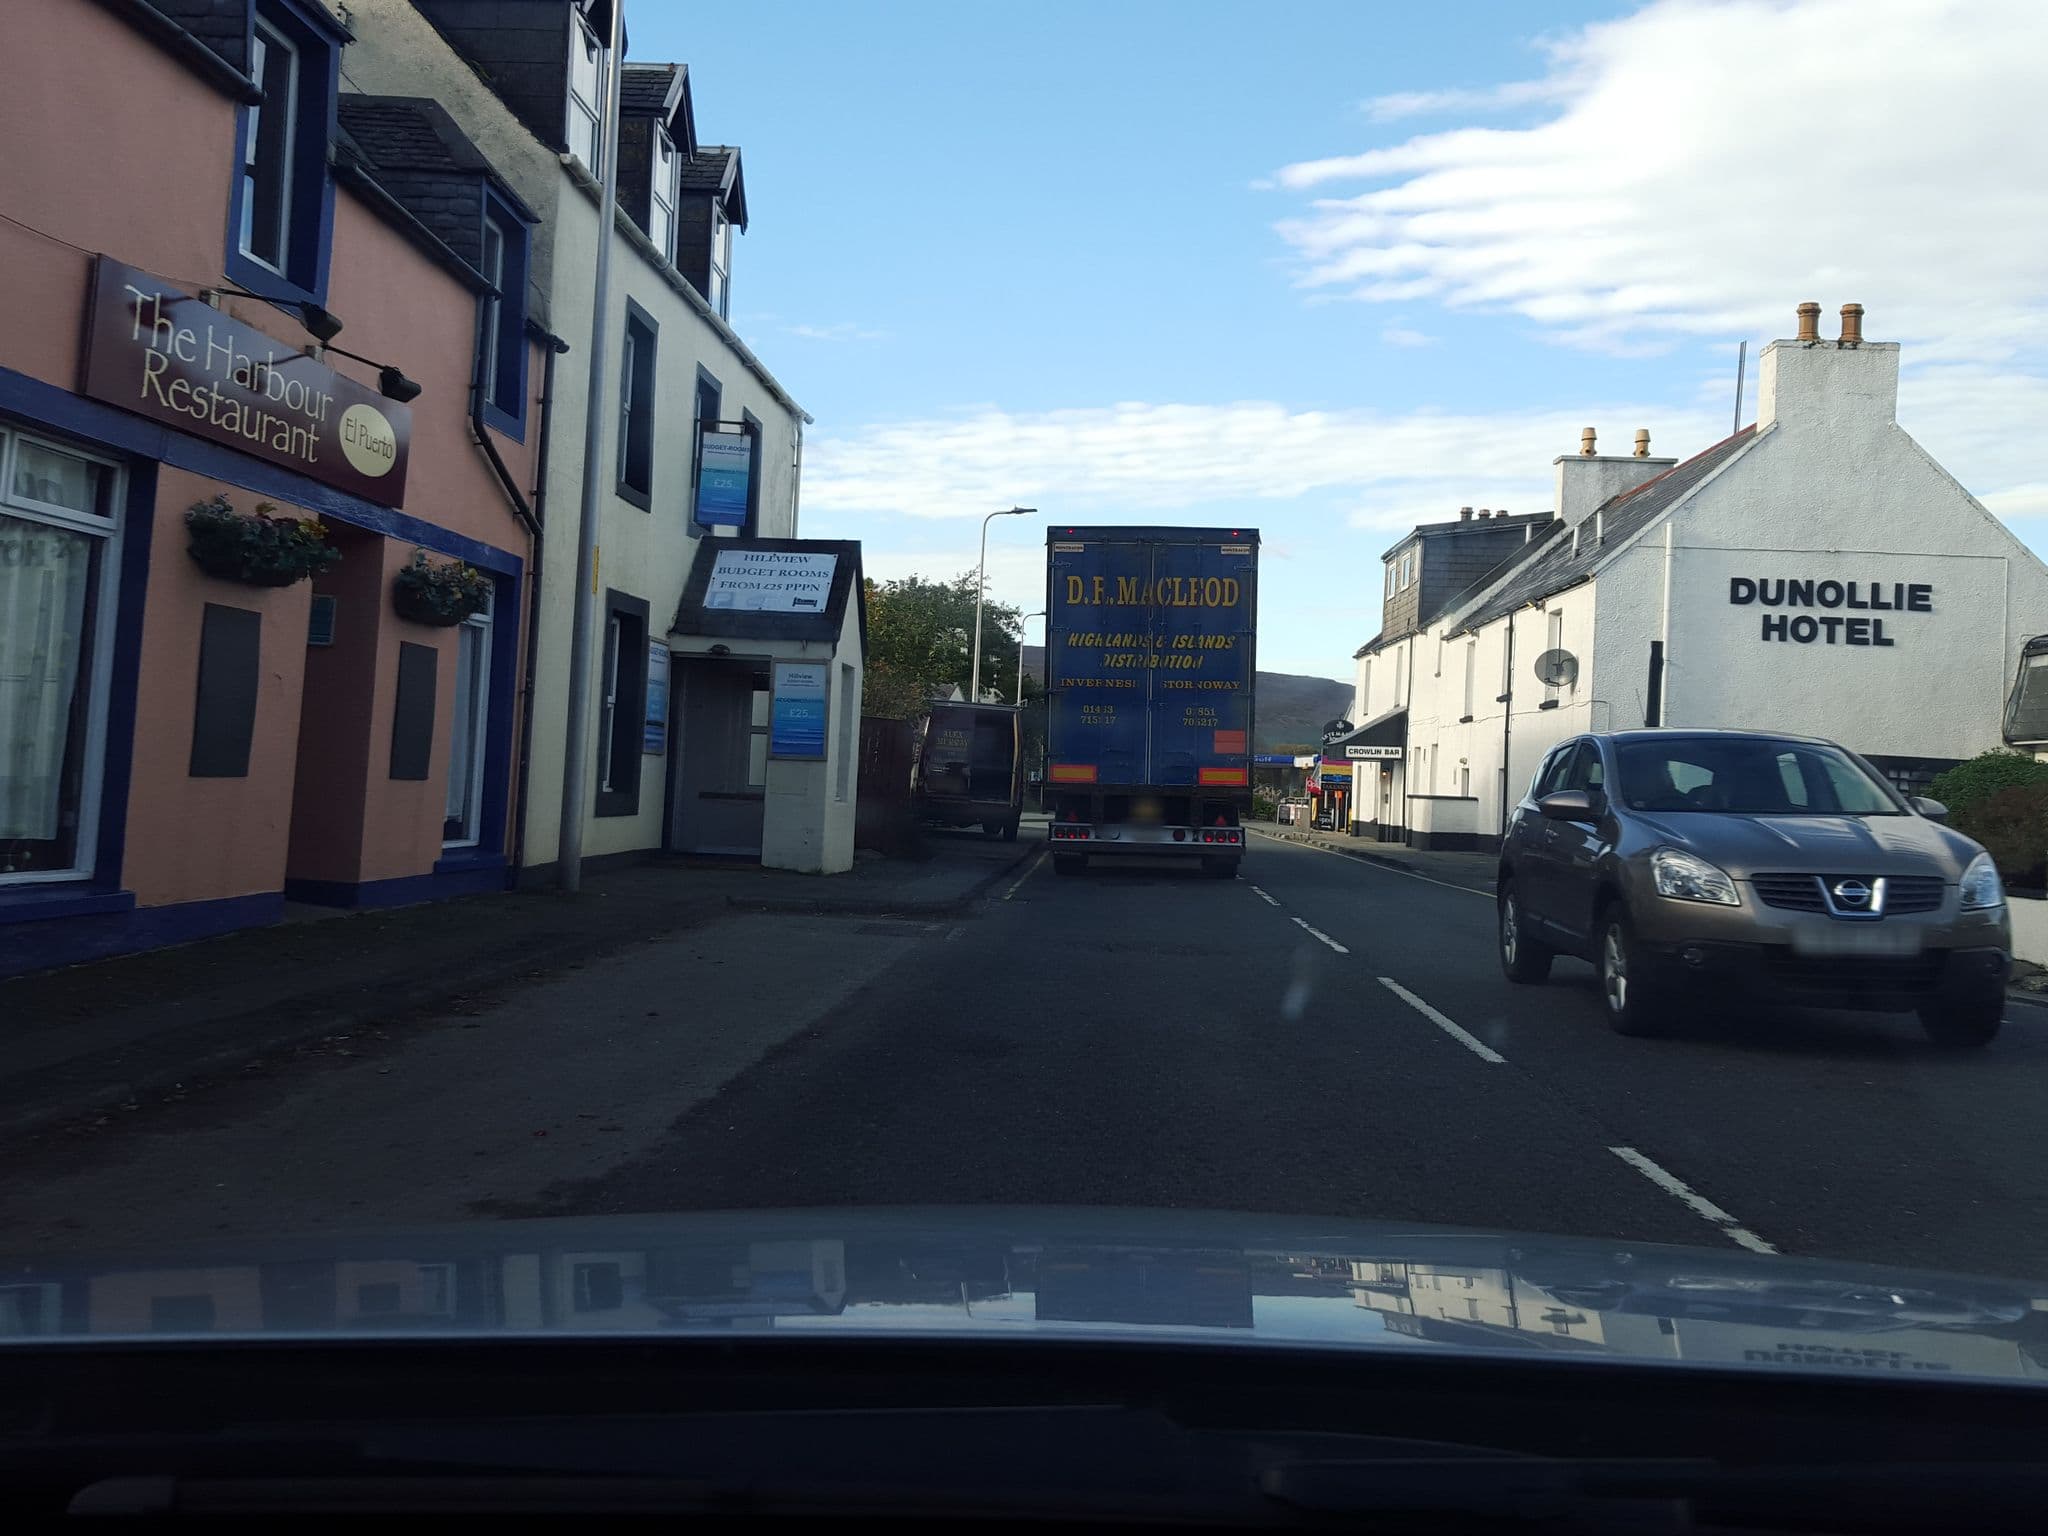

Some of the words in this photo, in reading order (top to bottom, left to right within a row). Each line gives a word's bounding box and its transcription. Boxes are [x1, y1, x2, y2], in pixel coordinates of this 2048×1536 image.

[124, 284, 196, 362] The
[205, 325, 334, 422] Harbour
[141, 347, 320, 463] Restaurant
[345, 417, 357, 443] El
[359, 424, 394, 461] Puerto
[744, 554, 812, 564] HILLVIEW
[718, 567, 777, 577] BUDGET
[779, 569, 830, 578] ROOMS
[720, 581, 760, 590] FROM
[763, 583, 783, 591] £25
[1730, 577, 1932, 612] DUNOLLIE
[1068, 632, 1150, 648] HIGHLANDS
[1172, 635, 1236, 650] ISLANDS
[1762, 614, 1895, 647] HOTEL
[1185, 707, 1216, 716] 0851
